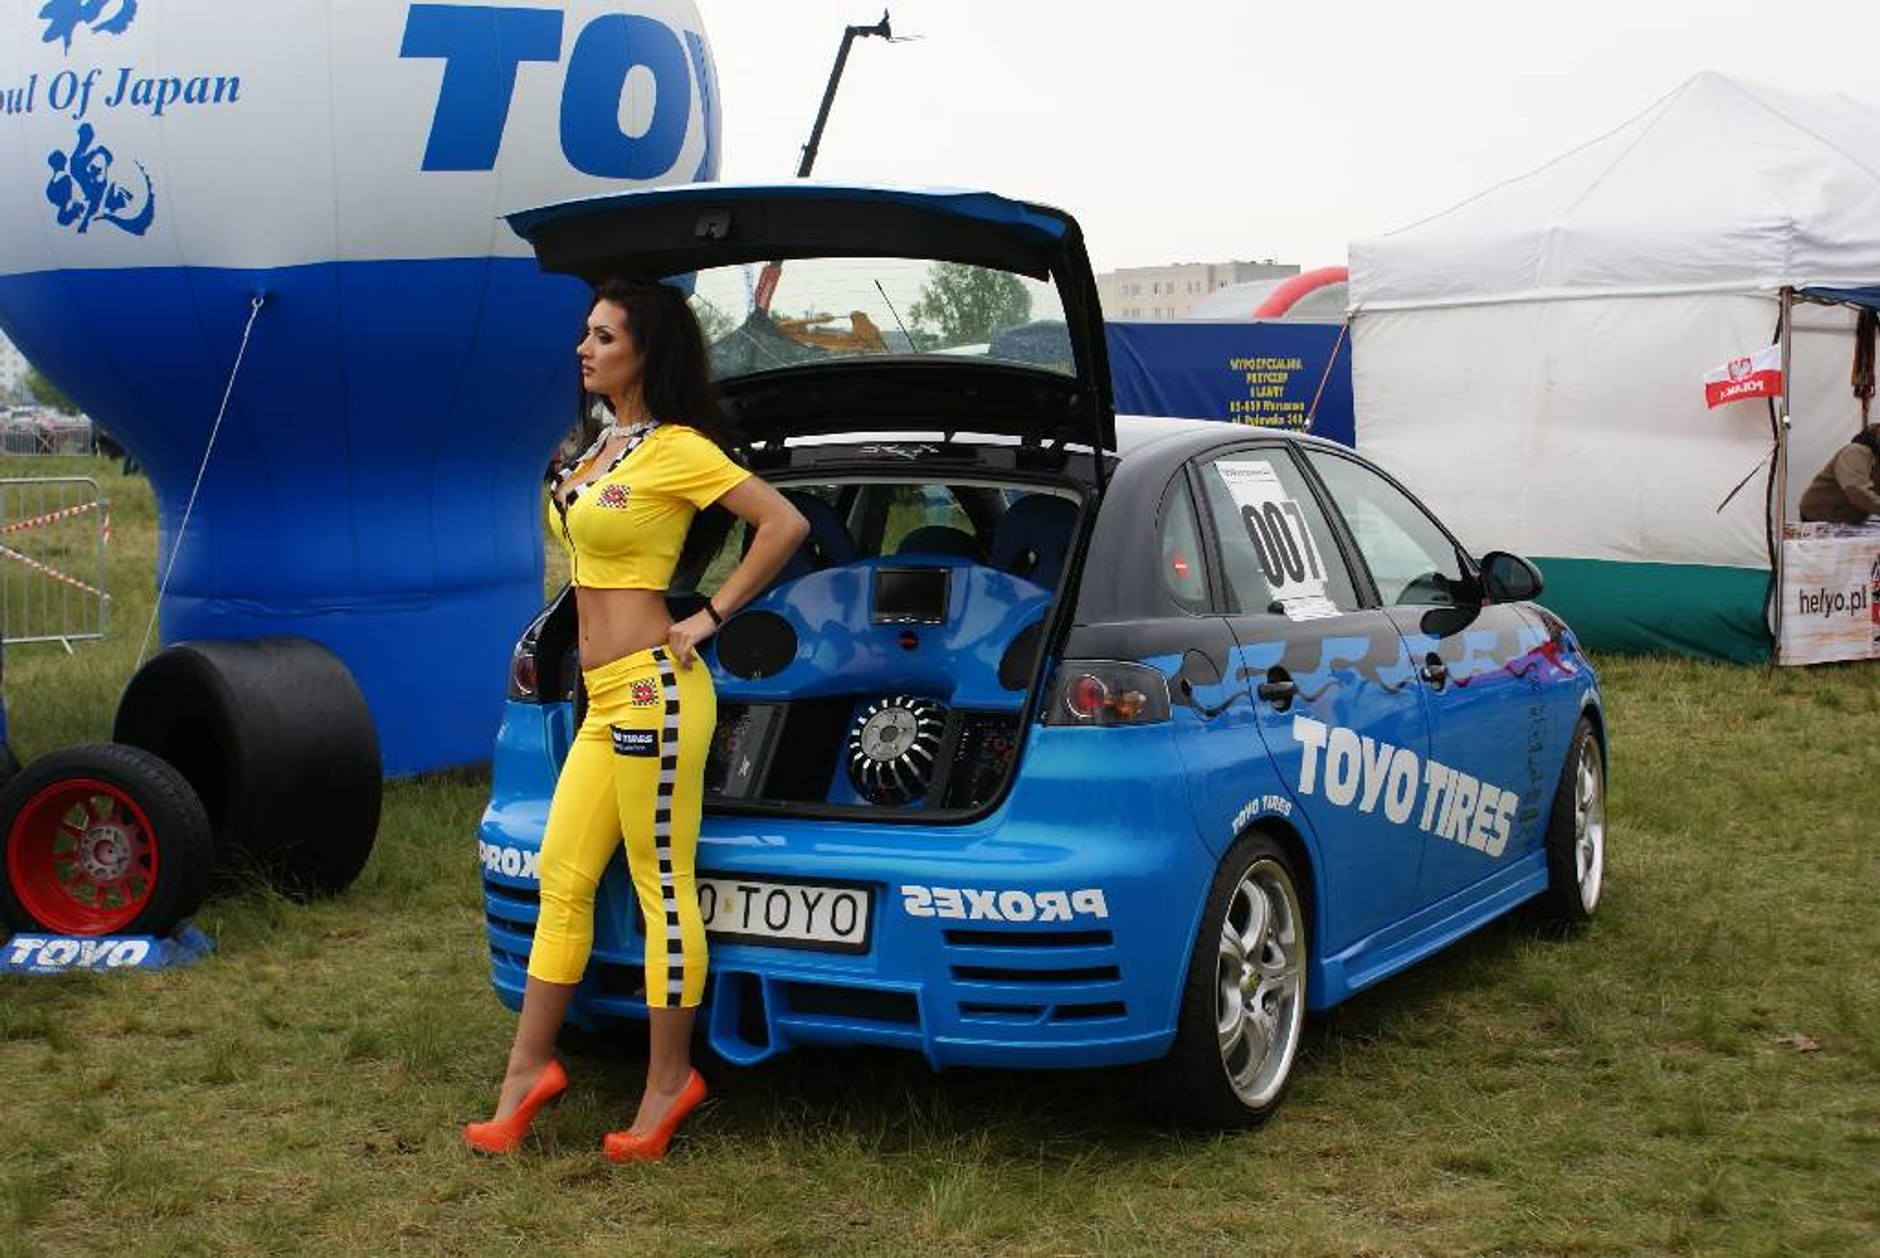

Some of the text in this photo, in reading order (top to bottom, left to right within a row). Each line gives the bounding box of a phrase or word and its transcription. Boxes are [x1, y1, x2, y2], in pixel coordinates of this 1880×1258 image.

[48, 69, 102, 120] Of
[105, 68, 241, 116] Japan
[1241, 501, 1321, 588] 007
[1292, 714, 1420, 825] TOYO
[1418, 759, 1520, 858] TIRES
[1231, 795, 1293, 836] TOYO TIRES
[737, 884, 858, 937] TOYO
[10, 938, 150, 967] TOYO
